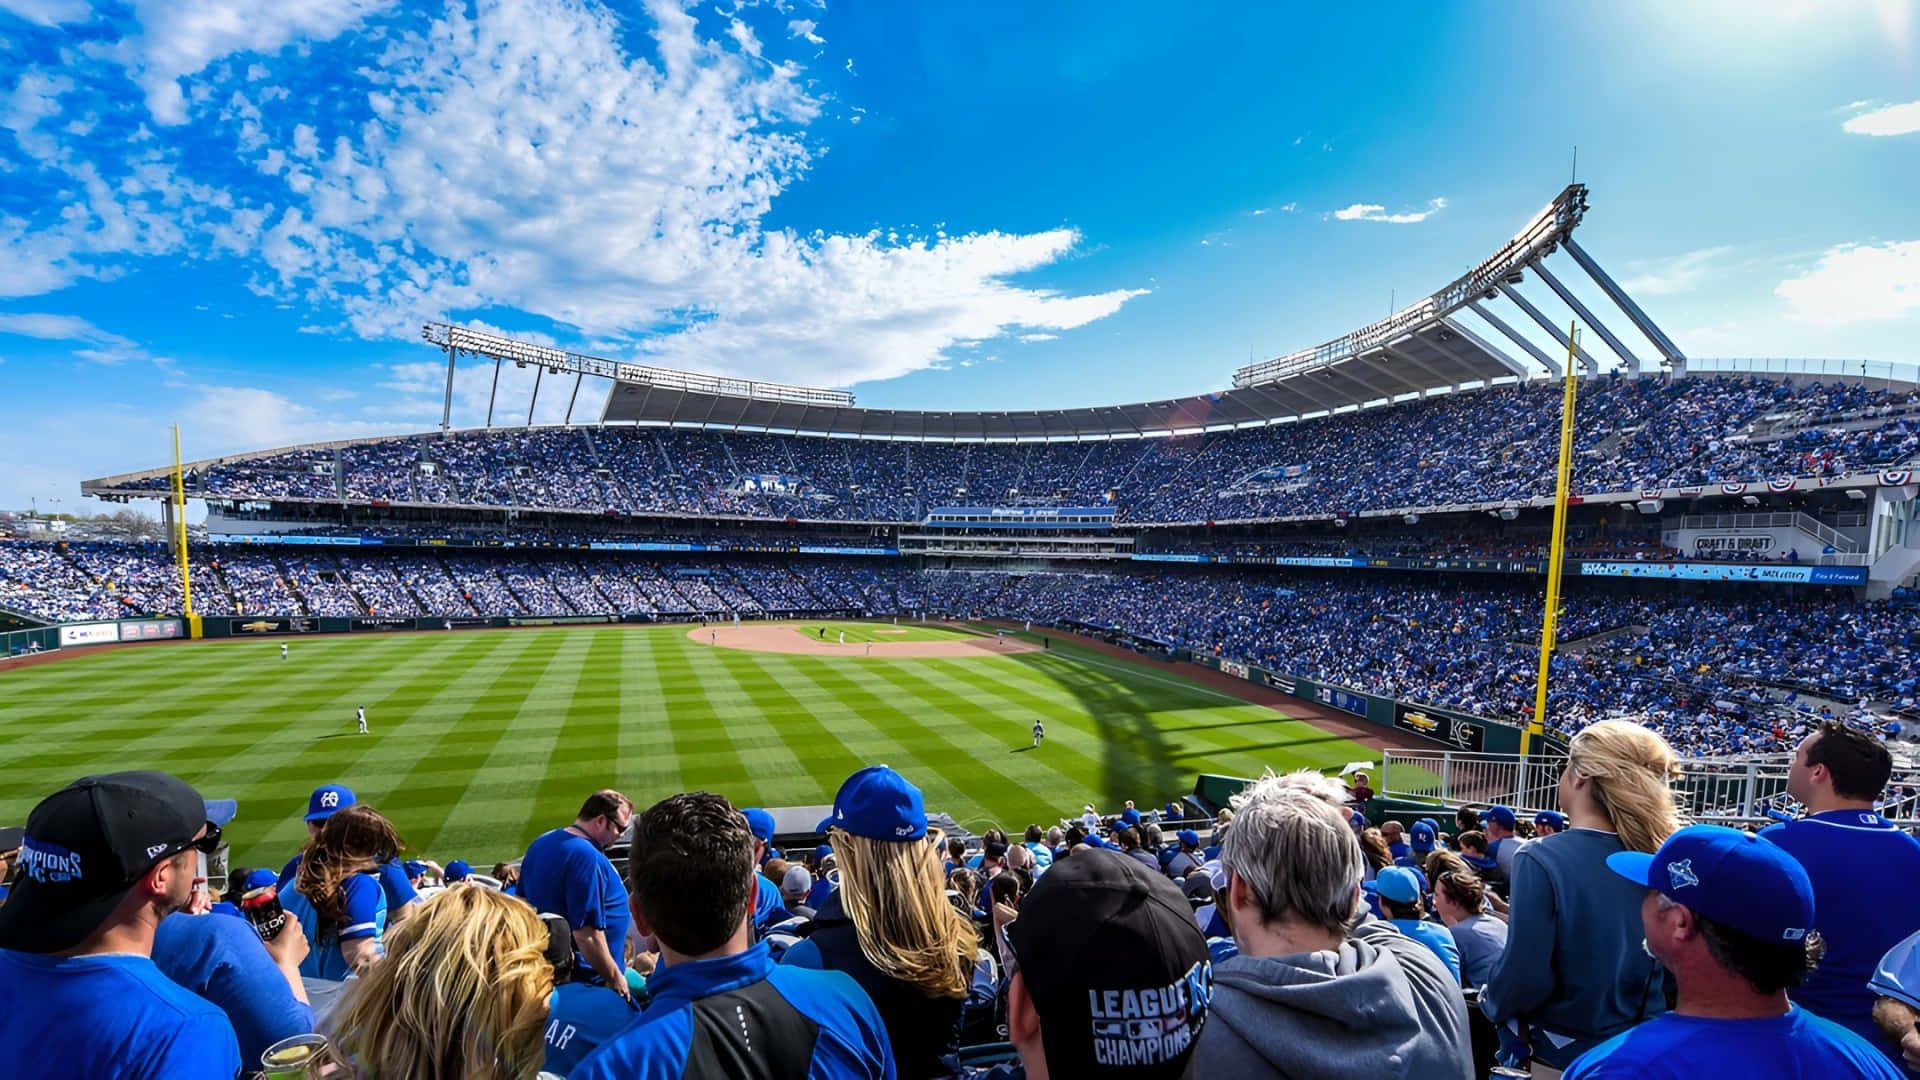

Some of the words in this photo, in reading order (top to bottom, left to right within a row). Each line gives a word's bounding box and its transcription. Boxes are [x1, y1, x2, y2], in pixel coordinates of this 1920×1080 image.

[1696, 537, 1726, 551] CRAFT
[1727, 538, 1735, 550] &
[1737, 537, 1771, 550] DRAFT
[1088, 978, 1187, 1019] LEAGUE
[1094, 1023, 1191, 1066] CHAMPIONS
